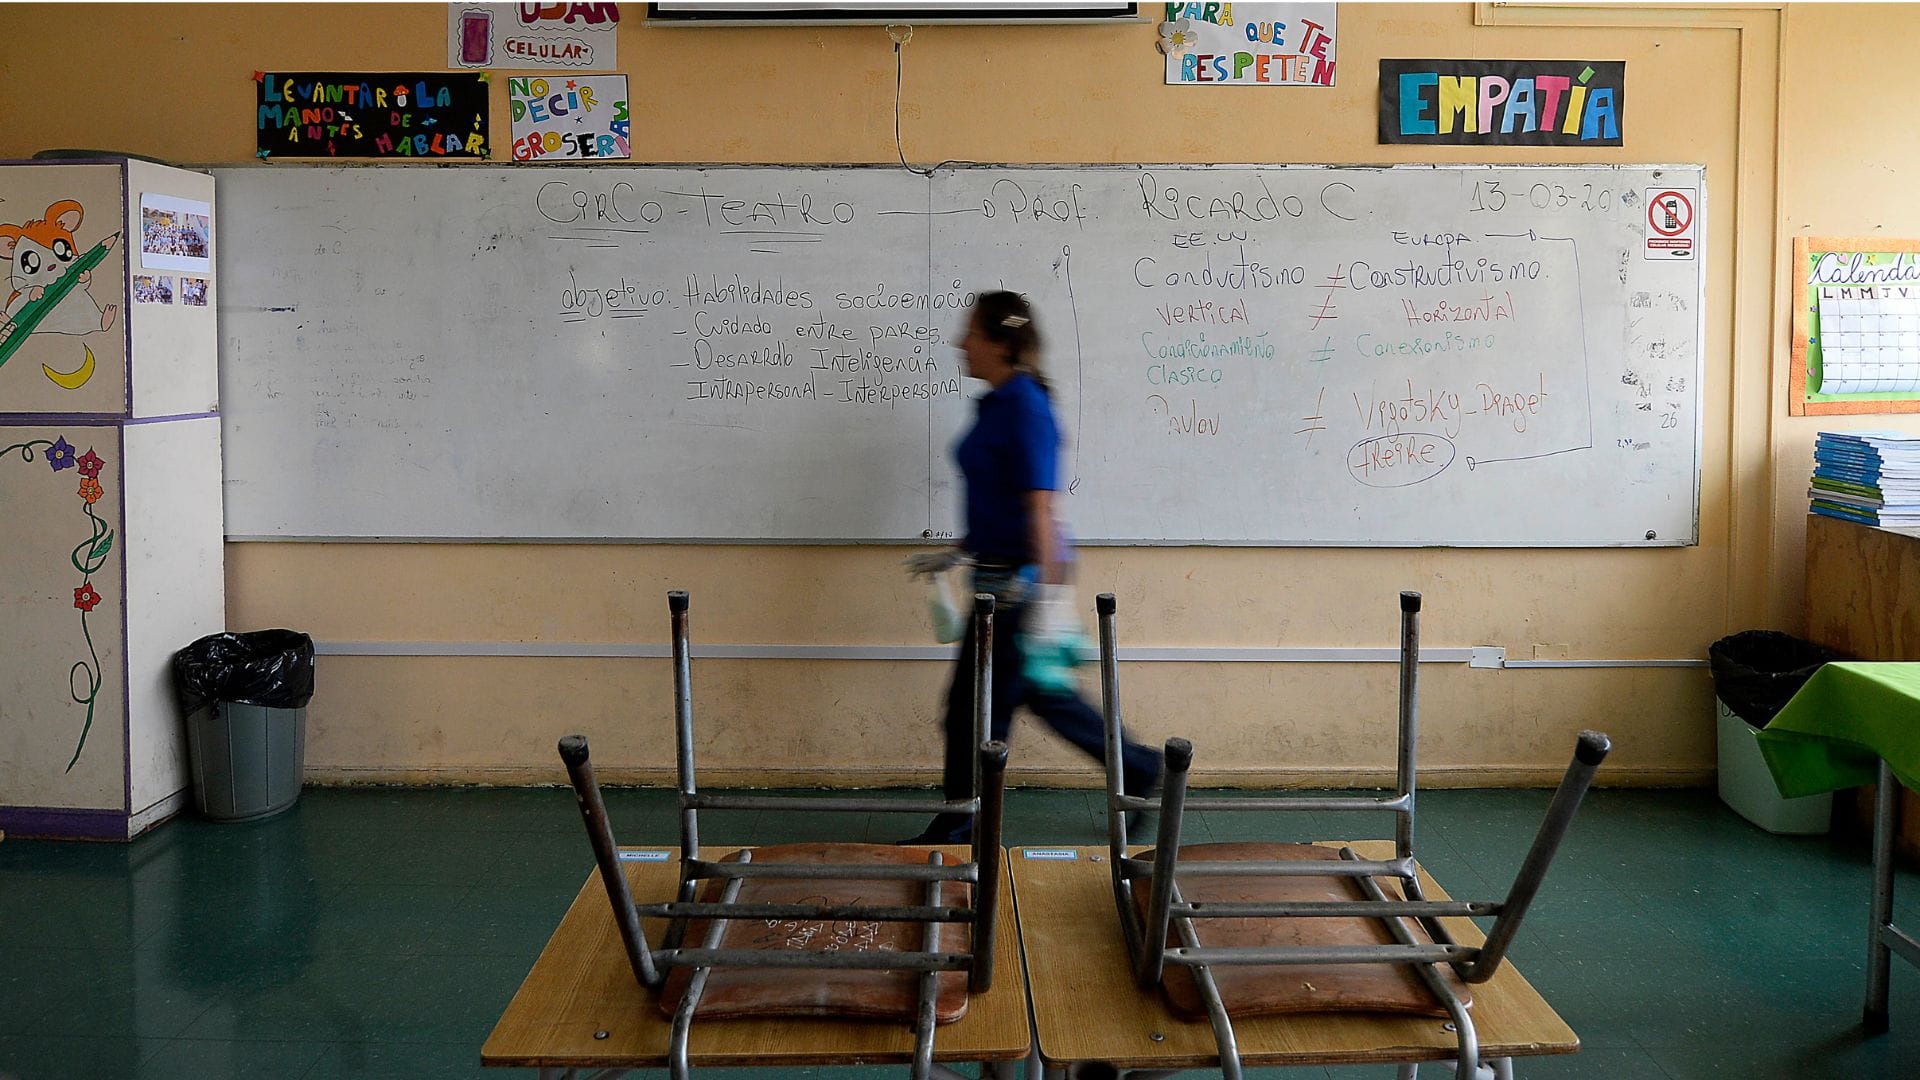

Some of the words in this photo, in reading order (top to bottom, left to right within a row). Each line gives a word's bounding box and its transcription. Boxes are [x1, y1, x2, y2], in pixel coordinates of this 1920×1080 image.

[1167, 2, 1233, 26] PARA
[506, 40, 582, 58] CELULAR
[1246, 22, 1286, 46] QUE
[1300, 19, 1332, 60] TE
[1181, 52, 1336, 86] RESPETEN
[265, 75, 388, 109] LEVANTAR
[416, 81, 450, 108] LA
[510, 78, 549, 97] NO
[512, 86, 598, 123] DECIR
[1399, 66, 1618, 140] EMPATÍA
[259, 104, 334, 129] MANO
[391, 112, 412, 126] DE
[289, 124, 363, 142] ANTES
[1138, 173, 1303, 221] Ricardo
[1823, 287, 1833, 298] L
[1841, 287, 1852, 299] M
[1860, 287, 1874, 299] M
[1899, 288, 1908, 297] V
[1659, 411, 1678, 428] 26
